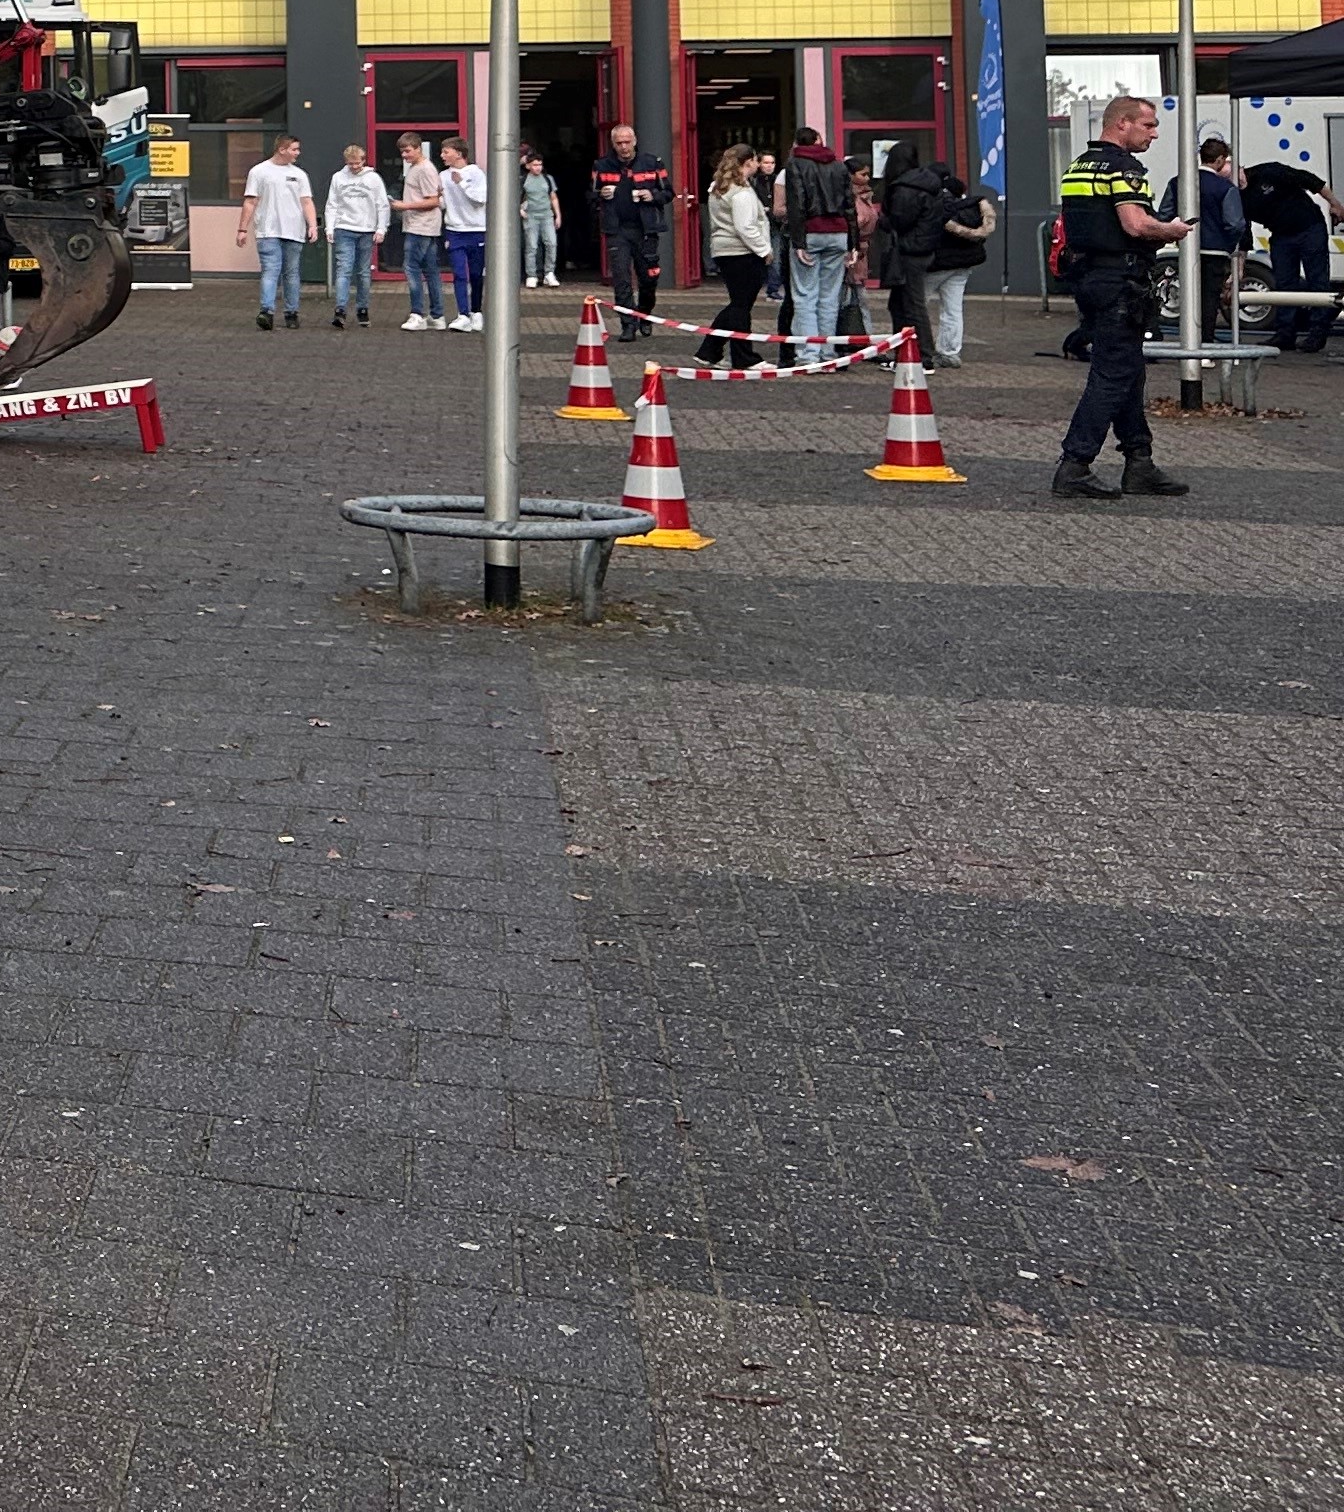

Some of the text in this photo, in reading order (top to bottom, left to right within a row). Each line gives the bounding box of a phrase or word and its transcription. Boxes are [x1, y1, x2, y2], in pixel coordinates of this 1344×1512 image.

[43, 397, 60, 413] &
[65, 392, 99, 410] ZN.
[104, 388, 132, 406] BV
